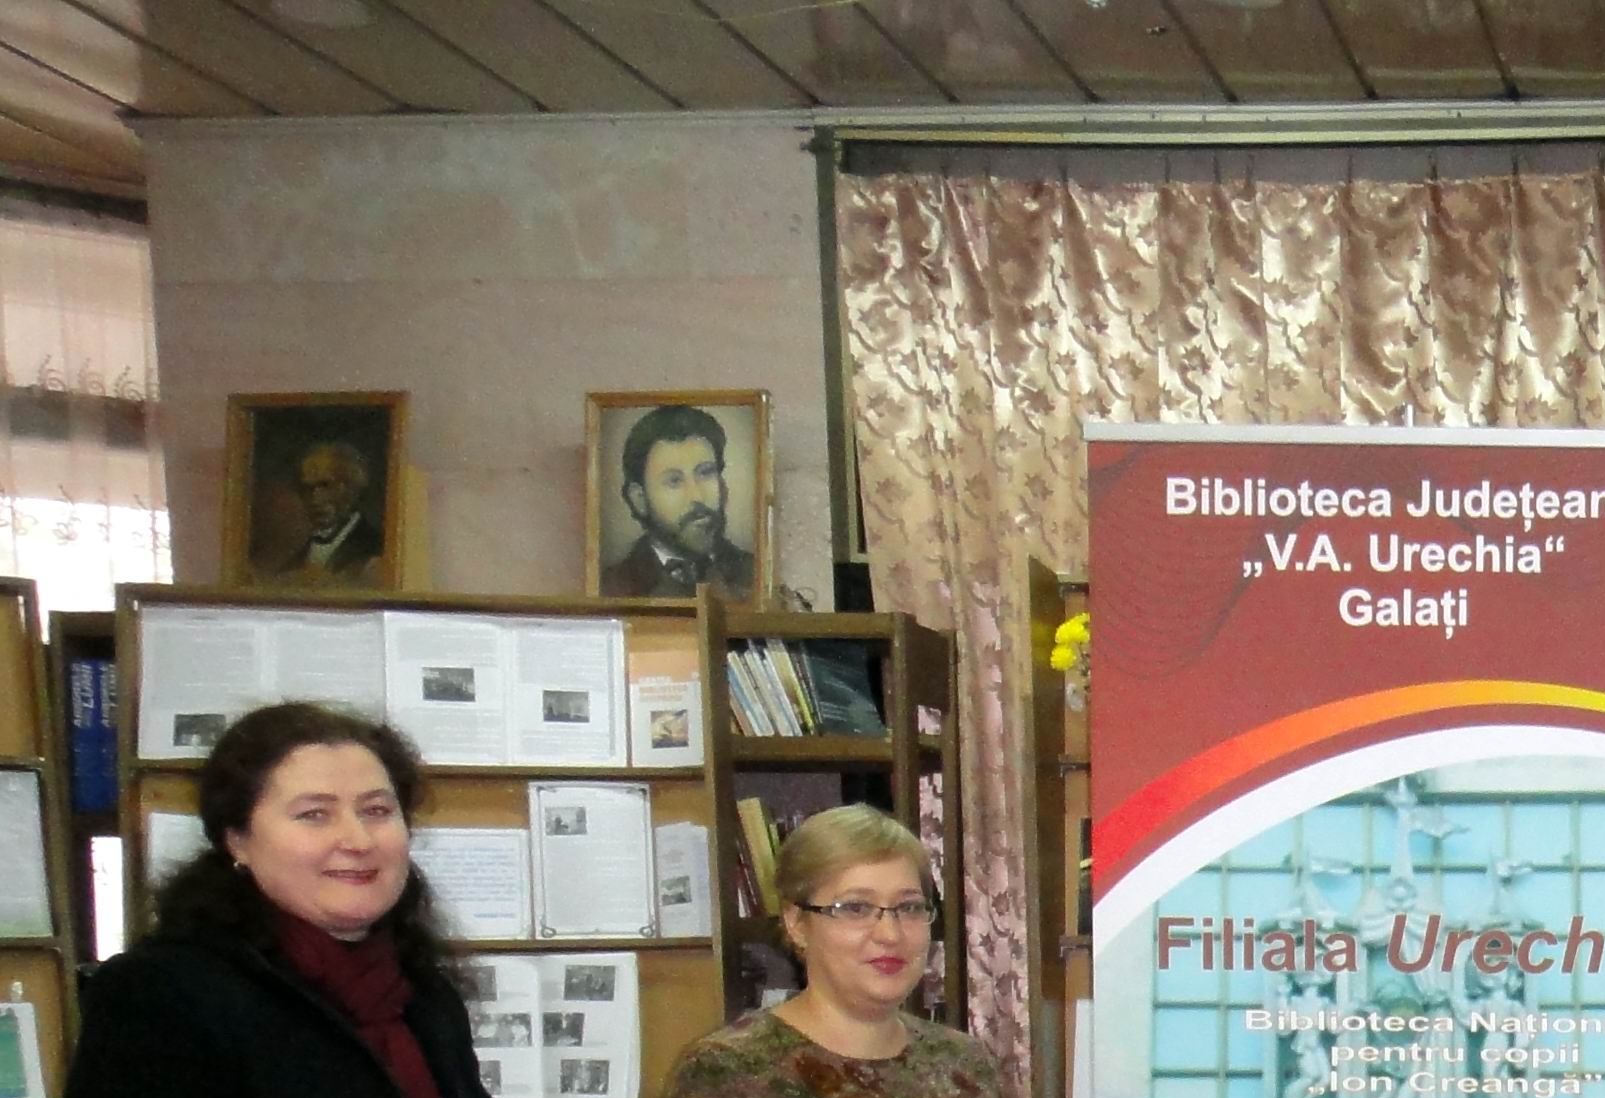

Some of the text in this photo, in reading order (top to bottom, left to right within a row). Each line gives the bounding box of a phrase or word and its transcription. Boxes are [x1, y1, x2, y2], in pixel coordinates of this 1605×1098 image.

[1166, 477, 1391, 518] Biblioteca
[1338, 588, 1469, 638] Galați
[1156, 916, 1359, 973] Filiala
[1244, 1008, 1455, 1033] Biblioteca
[1331, 1041, 1580, 1073] pentru copii
